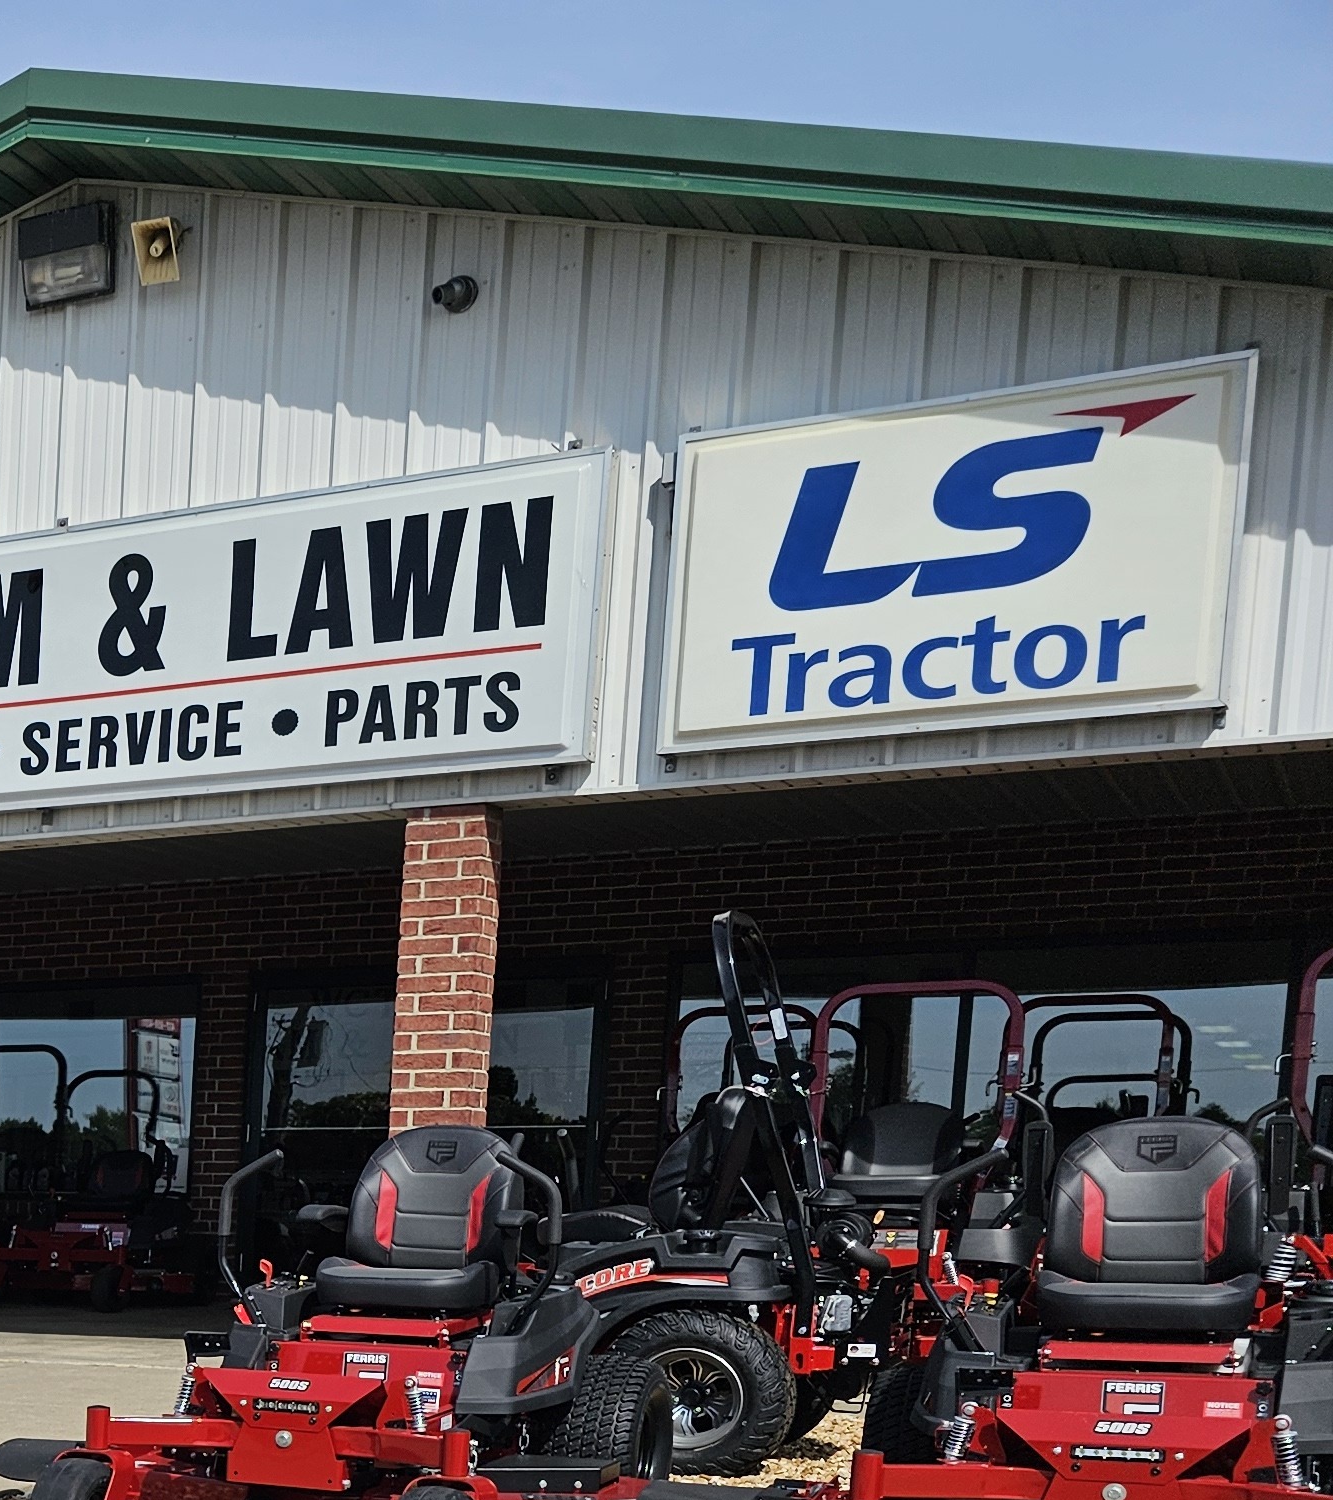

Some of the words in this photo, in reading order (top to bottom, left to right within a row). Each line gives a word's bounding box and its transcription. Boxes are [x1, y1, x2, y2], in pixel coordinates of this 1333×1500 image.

[769, 426, 1104, 611] LS
[97, 553, 166, 677] &
[226, 495, 554, 662] LAWN
[731, 615, 1146, 717] Tractor
[20, 700, 244, 776] SERVICE
[324, 670, 520, 748] PARTS
[576, 1258, 655, 1294] CORE
[346, 1353, 387, 1364] FERRIS
[269, 1378, 310, 1391] 500S
[1106, 1382, 1162, 1394] FERRIS
[1206, 1402, 1241, 1410] NOTICE
[1094, 1421, 1152, 1435] 500S
